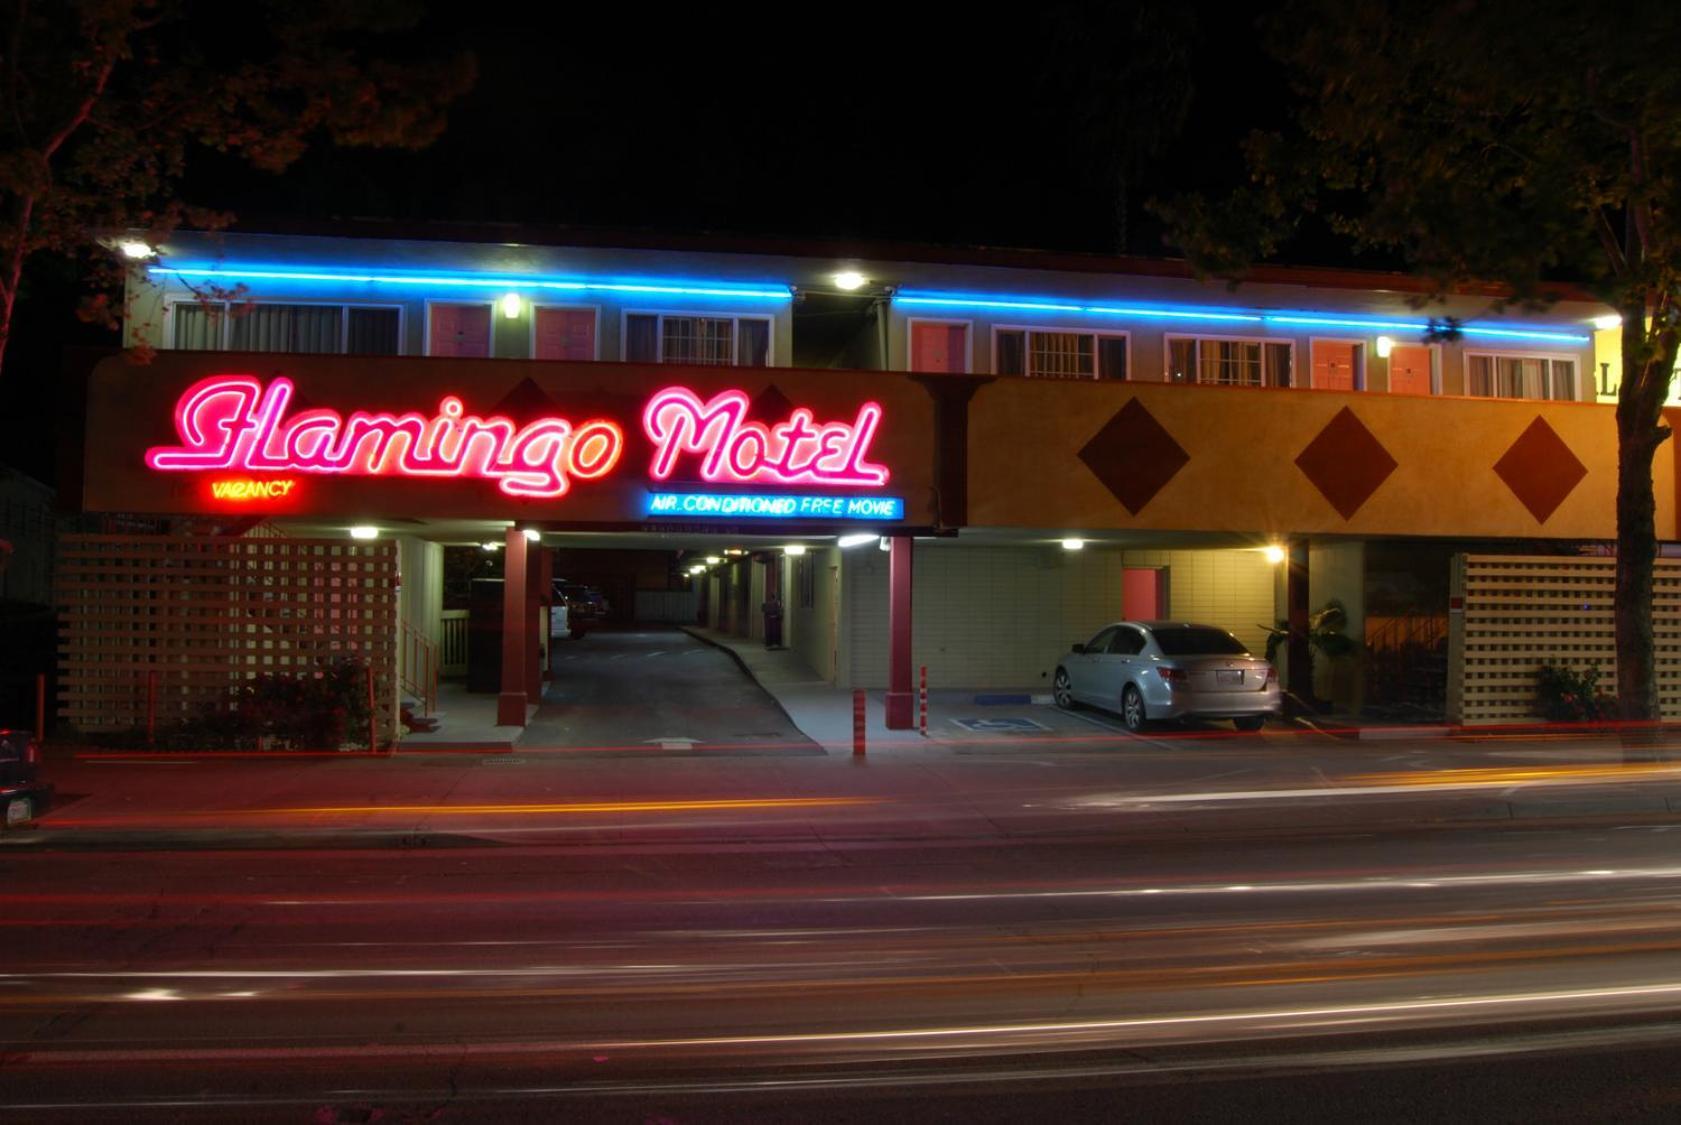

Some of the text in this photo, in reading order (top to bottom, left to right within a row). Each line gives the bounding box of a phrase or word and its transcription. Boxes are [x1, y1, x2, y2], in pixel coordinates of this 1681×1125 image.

[146, 376, 890, 498] Flamingo Motel
[212, 479, 294, 499] VACANCY
[847, 501, 896, 516] MOVIE
